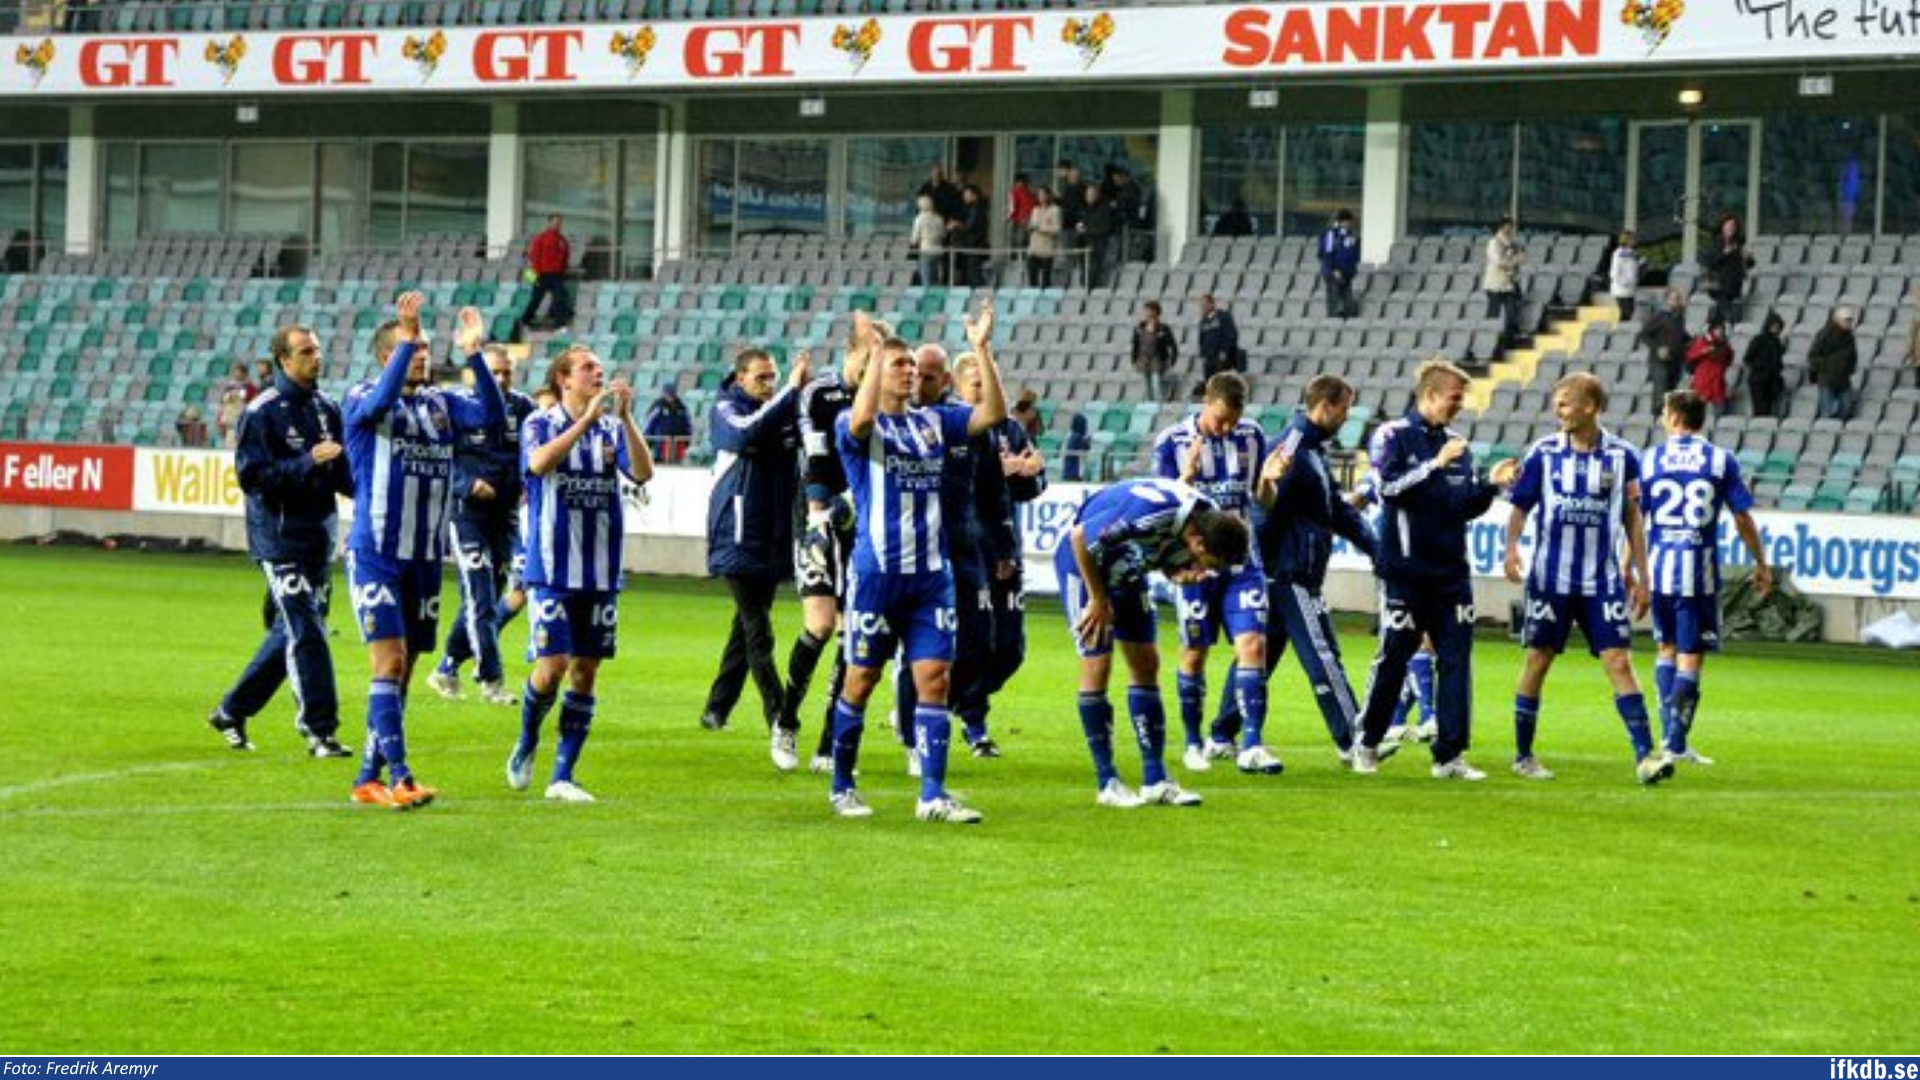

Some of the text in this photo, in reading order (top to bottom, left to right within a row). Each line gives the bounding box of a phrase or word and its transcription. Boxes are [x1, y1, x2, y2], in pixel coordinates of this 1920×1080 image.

[472, 30, 583, 82] GT
[683, 24, 800, 77] GT
[908, 17, 1033, 73] GT
[1222, 0, 1600, 66] SANKTAN
[79, 38, 178, 87] GT
[271, 34, 377, 84] GT
[23, 454, 78, 490] eller
[153, 455, 239, 505] Walle
[1650, 479, 1715, 527] 28
[418, 595, 442, 621] IC
[592, 603, 619, 627] IC
[851, 610, 891, 635] ICA
[934, 606, 960, 632] IC
[1456, 604, 1476, 624] IC
